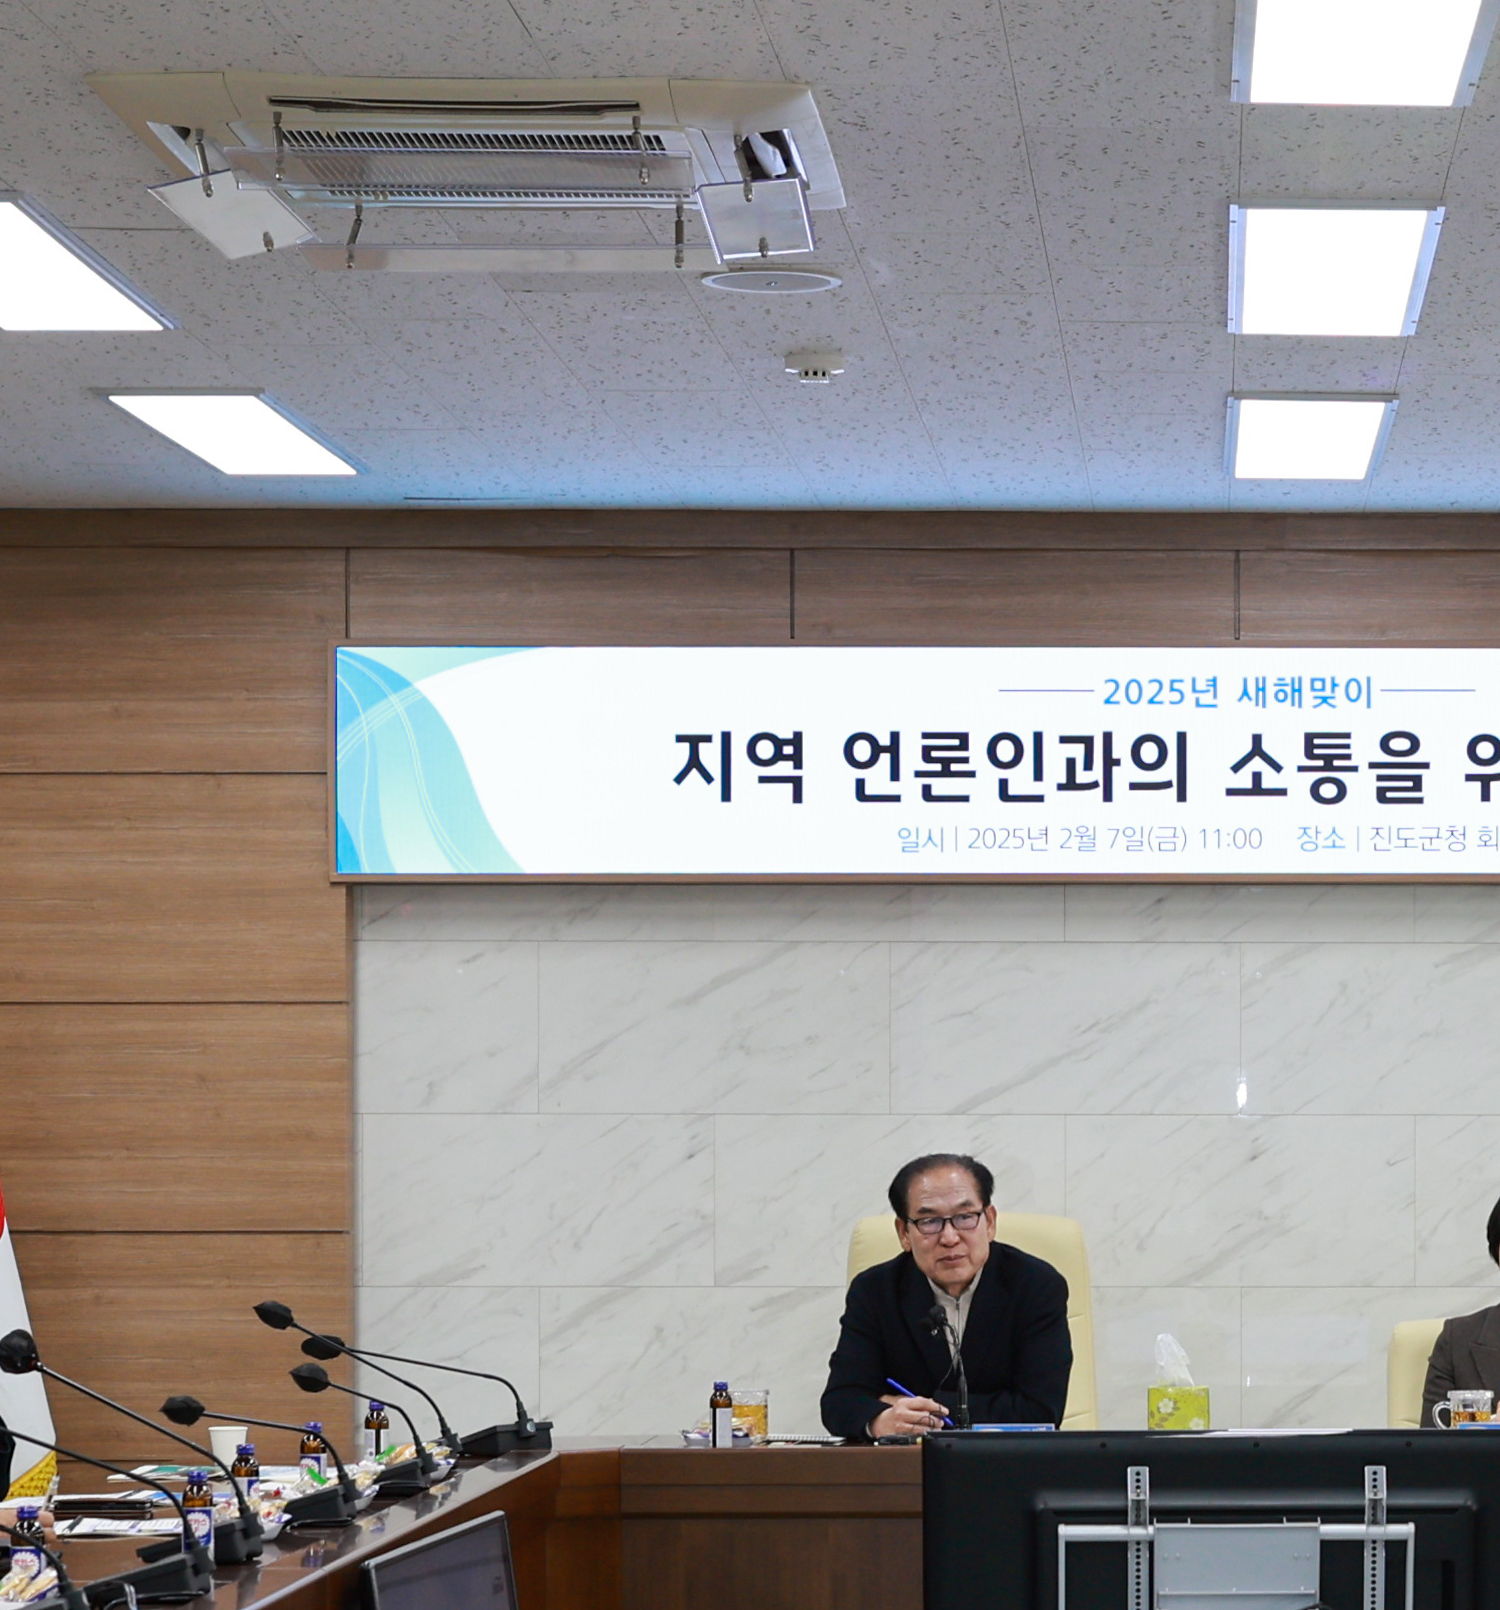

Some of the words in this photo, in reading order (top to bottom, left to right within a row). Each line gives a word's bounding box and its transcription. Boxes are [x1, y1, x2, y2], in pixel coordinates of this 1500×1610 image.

[1104, 676, 1218, 708] 2025년
[1238, 676, 1371, 709] 새해맞이
[673, 731, 803, 804] 지역
[843, 731, 1187, 803] 언론인과의
[1225, 731, 1430, 805] 소통을
[898, 827, 943, 853] 일시
[968, 826, 1048, 851] 2025년
[1060, 825, 1096, 852] 2월
[1107, 826, 1186, 852] 7일(금)
[1200, 828, 1262, 849] 11:00
[1297, 826, 1346, 852] 장소
[1370, 826, 1466, 852] 진도군청
